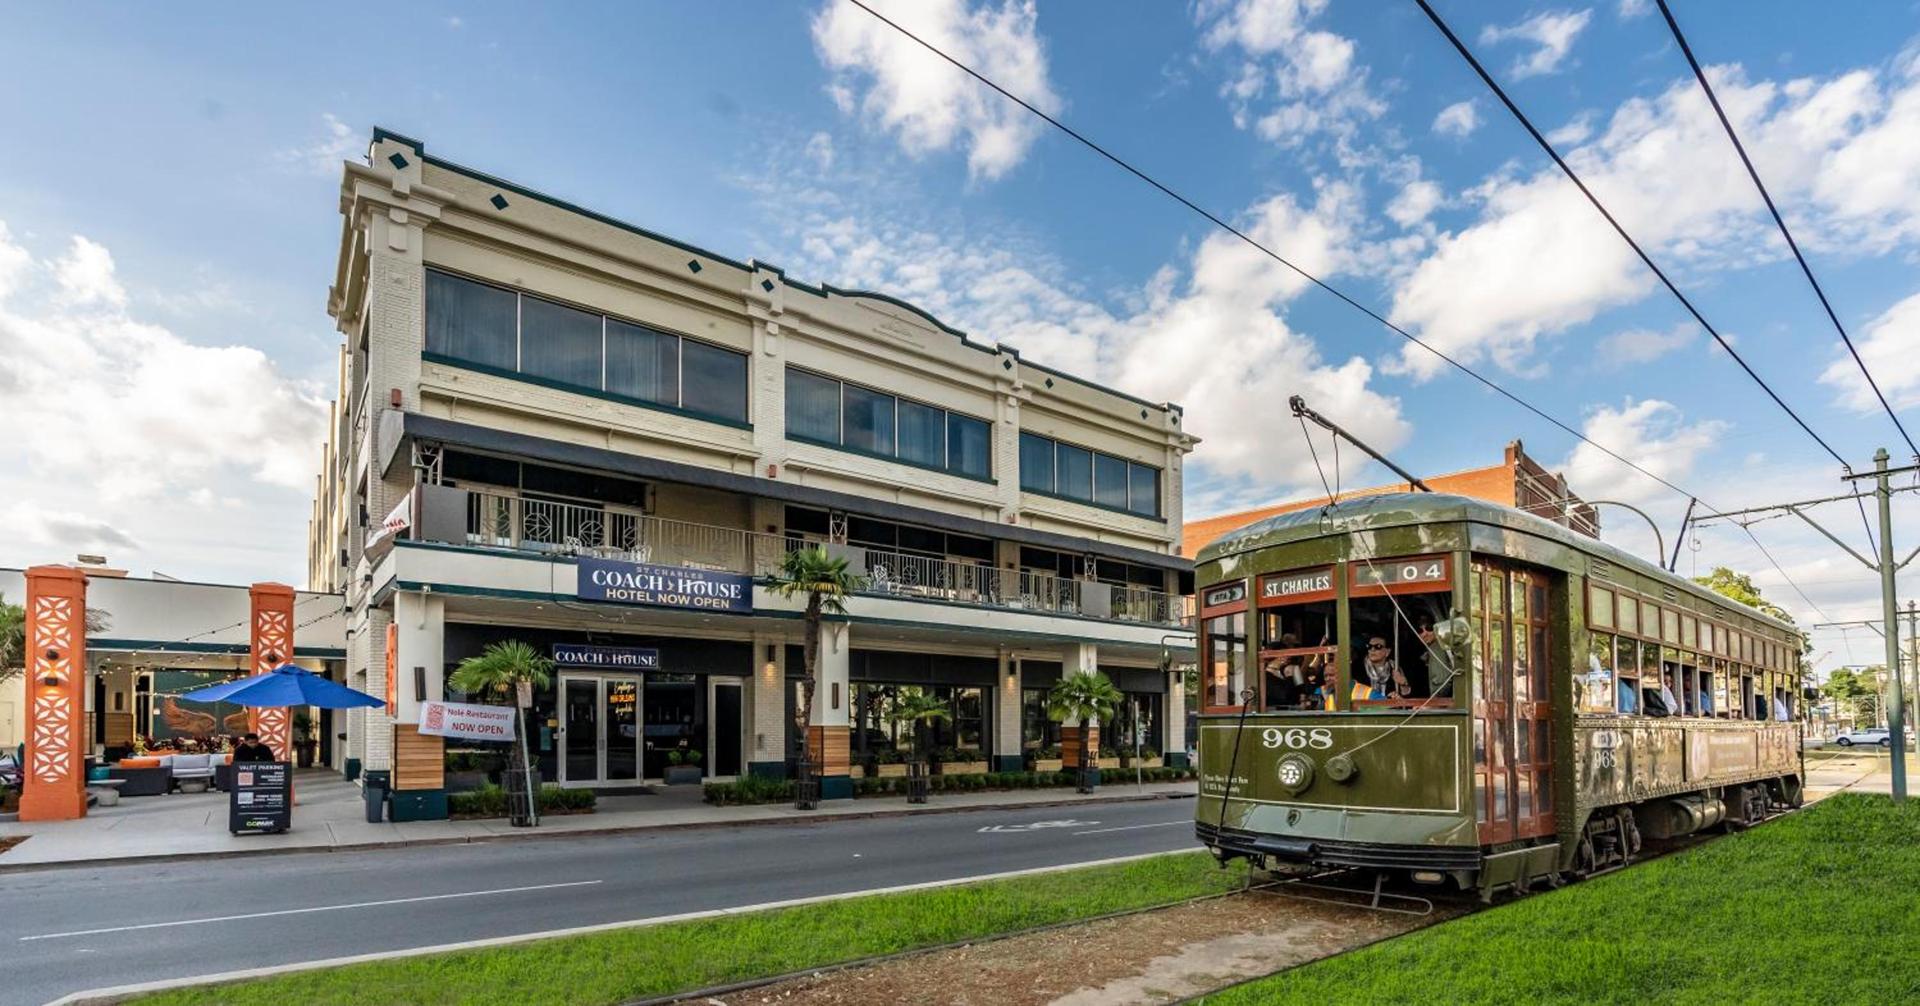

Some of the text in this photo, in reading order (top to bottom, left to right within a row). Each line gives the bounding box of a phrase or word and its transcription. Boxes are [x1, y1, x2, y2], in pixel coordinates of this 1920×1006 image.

[592, 569, 742, 599] COACH HOUSE
[654, 569, 704, 580] CHARLES
[1265, 575, 1330, 596] ST. CHARLES
[606, 588, 730, 609] HOTEL NOW OPEN
[555, 651, 657, 666] COACH HOUSE
[467, 710, 509, 720] Restaurant
[452, 722, 504, 734] NOW OPEN
[1262, 728, 1334, 750] 968
[1594, 750, 1616, 769] 968
